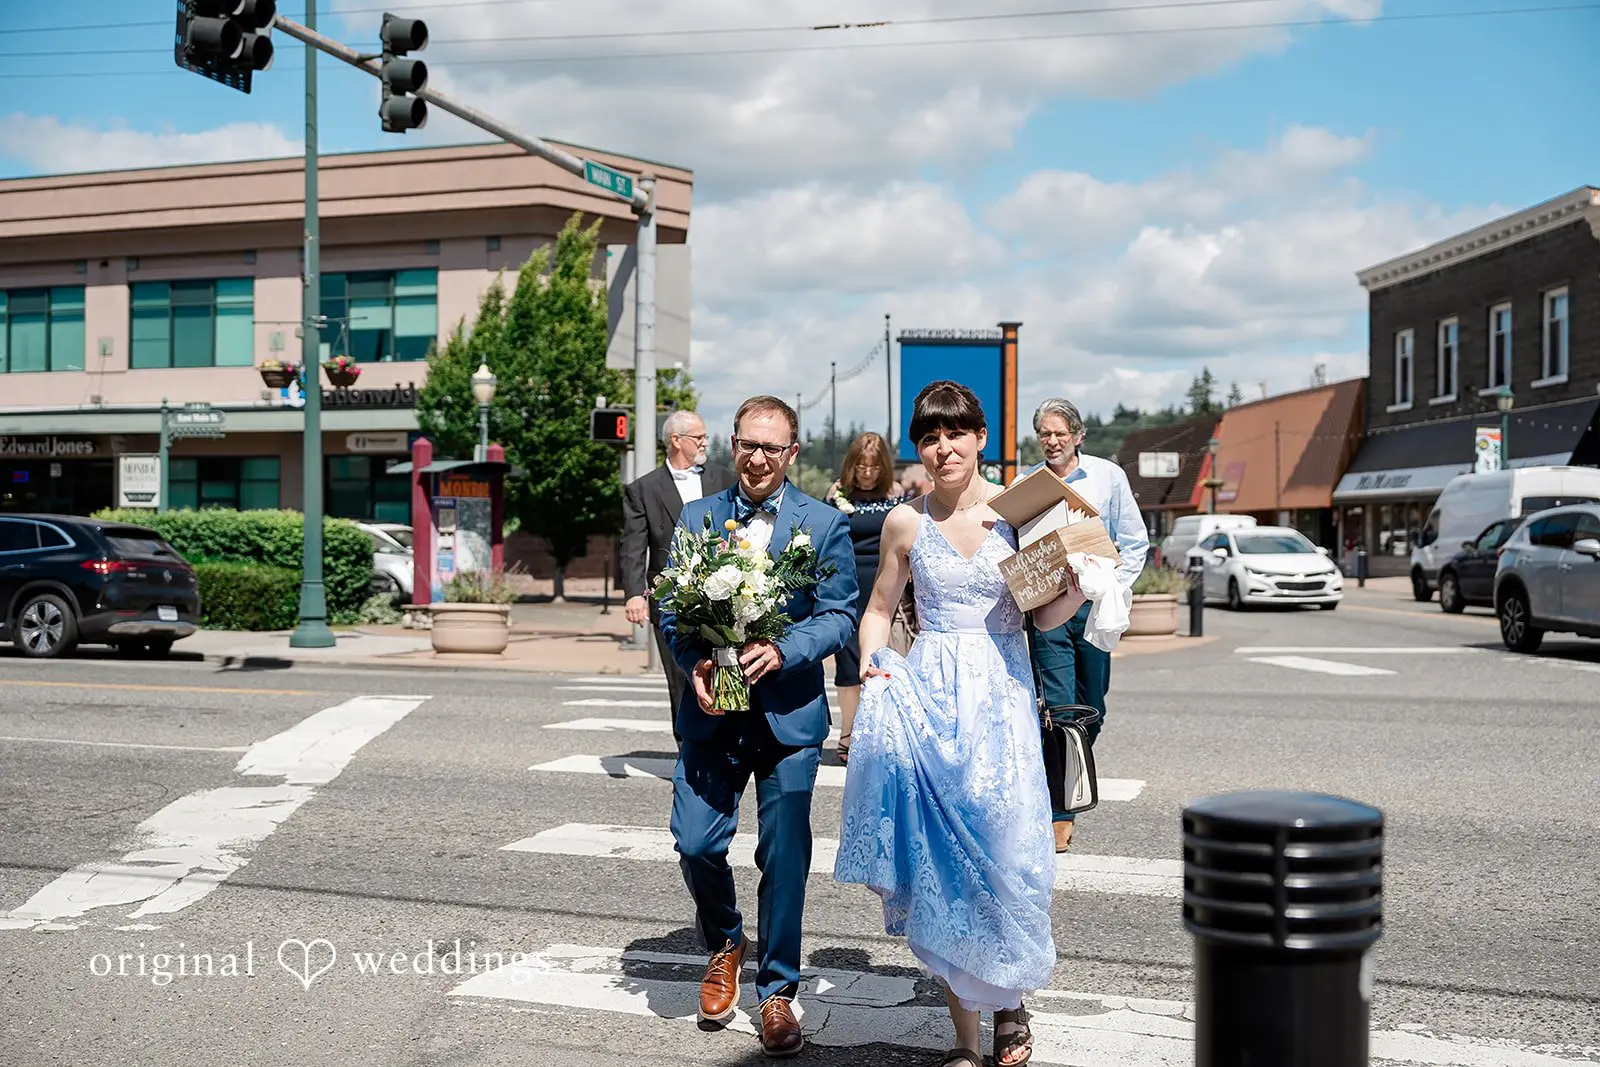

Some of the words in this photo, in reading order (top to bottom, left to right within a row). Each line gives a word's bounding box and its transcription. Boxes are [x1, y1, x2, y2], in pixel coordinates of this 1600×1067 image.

[591, 165, 612, 187] MAIN
[616, 415, 627, 438] 8
[0, 435, 50, 453] Edward
[51, 436, 94, 456] Jones
